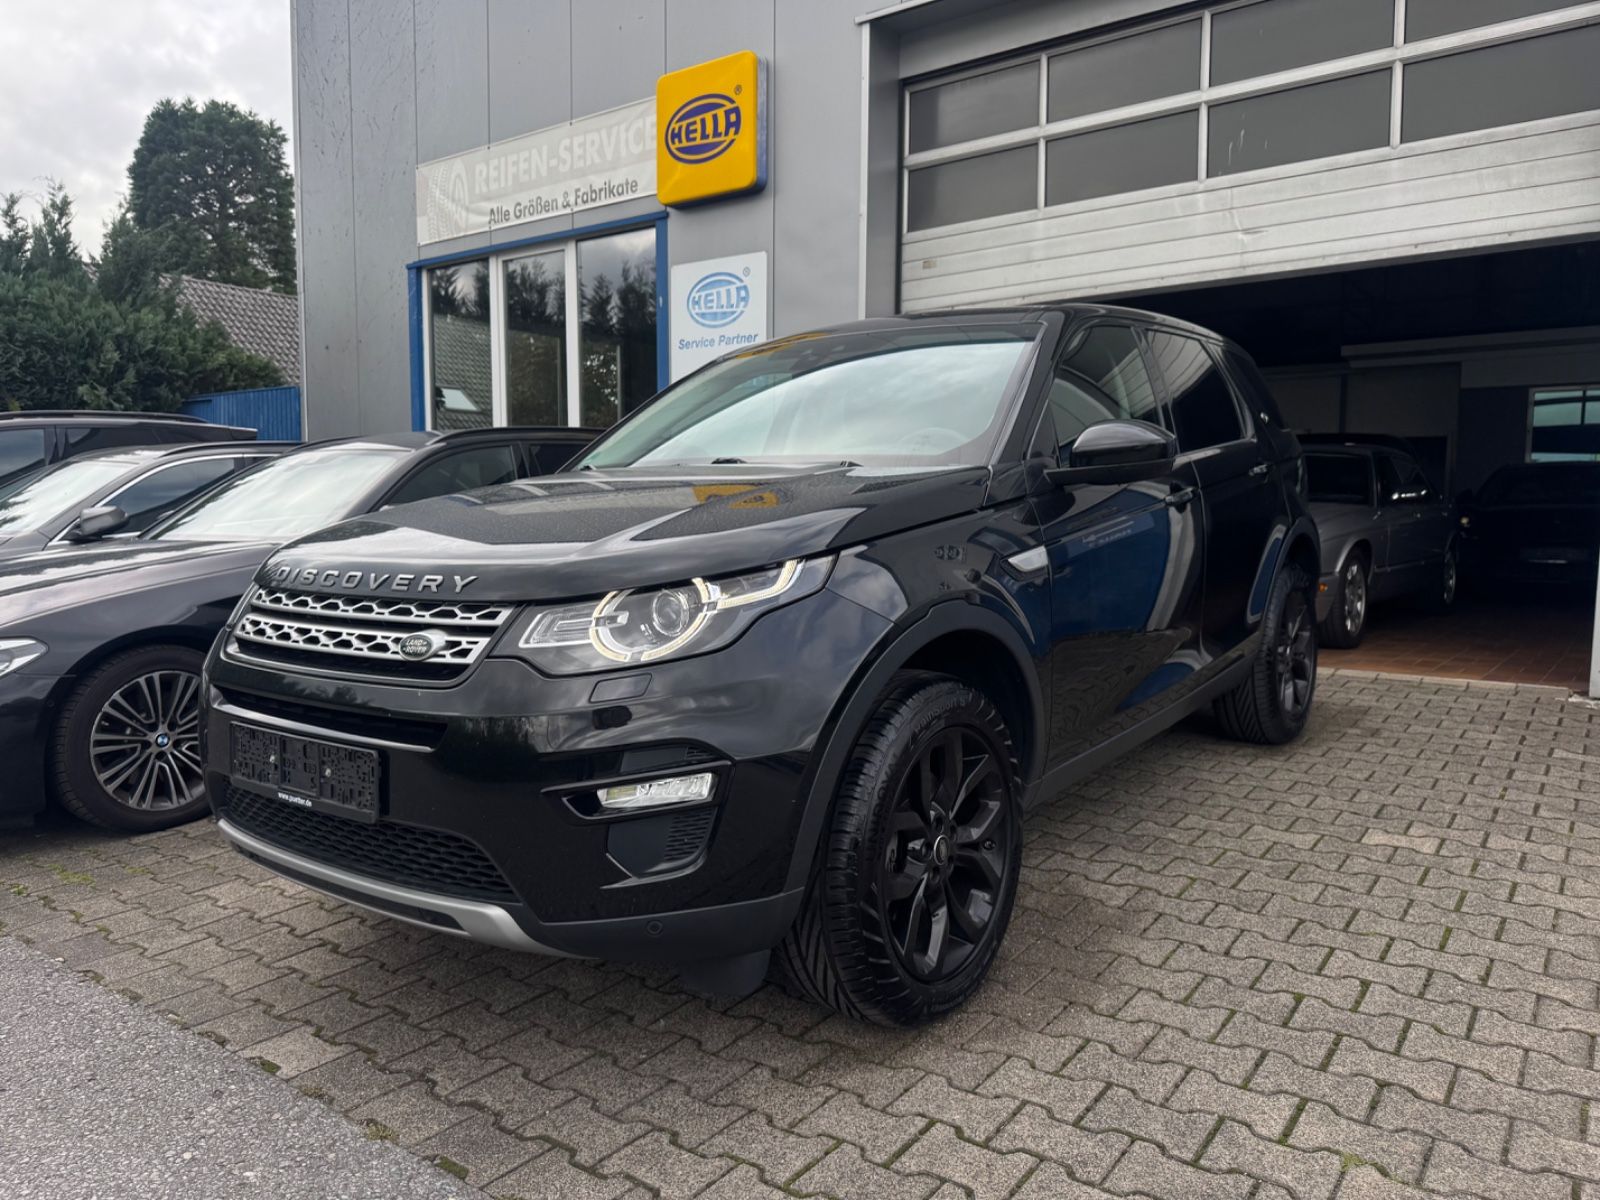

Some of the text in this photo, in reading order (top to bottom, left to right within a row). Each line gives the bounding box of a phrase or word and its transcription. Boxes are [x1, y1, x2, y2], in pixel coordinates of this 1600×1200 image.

[670, 106, 741, 145] HELLA
[474, 116, 656, 195] REIFEN-SERVICE
[488, 179, 639, 224] Alle Größen & Fabrikate
[691, 284, 749, 311] HELLA
[678, 333, 758, 350] Service Partner
[275, 566, 478, 593] DISCOVERY
